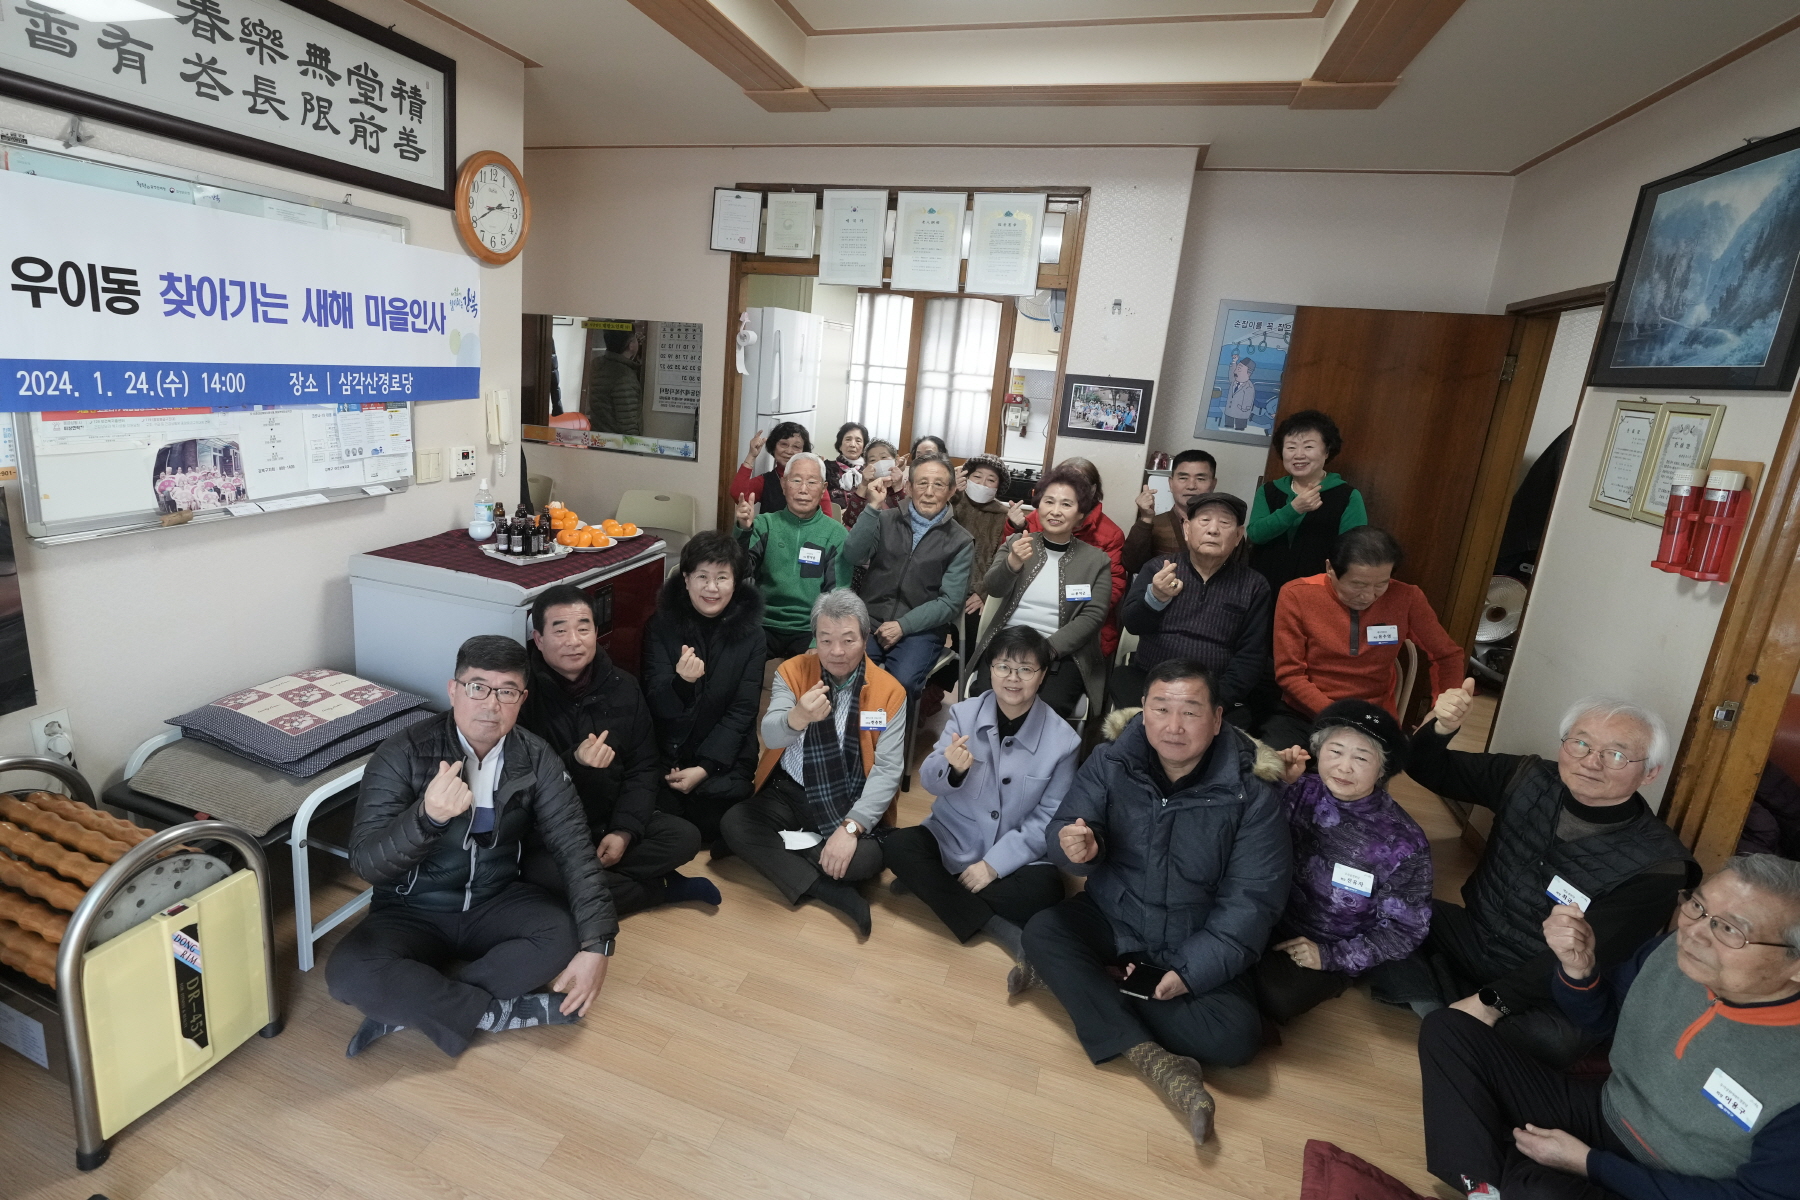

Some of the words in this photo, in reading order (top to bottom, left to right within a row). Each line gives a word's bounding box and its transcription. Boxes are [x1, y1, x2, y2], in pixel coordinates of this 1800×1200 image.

[480, 170, 486, 183] 11
[490, 168, 498, 182] 12
[472, 180, 479, 193] 10
[502, 176, 506, 188] 1
[469, 196, 474, 209] 9
[510, 190, 514, 202] 2
[512, 208, 517, 220] 3
[472, 216, 478, 228] 8
[508, 224, 513, 234] 4
[480, 230, 485, 242] 7
[490, 236, 496, 248] 6
[501, 234, 506, 246] 5
[11, 256, 141, 315] 우이동
[159, 272, 288, 324] 찾아가는
[302, 288, 354, 330] 새해
[365, 294, 446, 335] 마을인사
[463, 288, 478, 318] 강북
[1234, 320, 1262, 330] 손잡이를
[16, 371, 80, 397] 2024.
[94, 371, 112, 396] 1.
[124, 370, 189, 397] 24.(수)
[201, 372, 246, 394] 14:00
[289, 371, 318, 396] 장소
[338, 371, 414, 395] 삼각산경로당
[174, 934, 198, 952] DONG
[180, 950, 198, 964] RIM
[186, 976, 204, 1039] DR-451
[1725, 1096, 1746, 1114] 이용구
